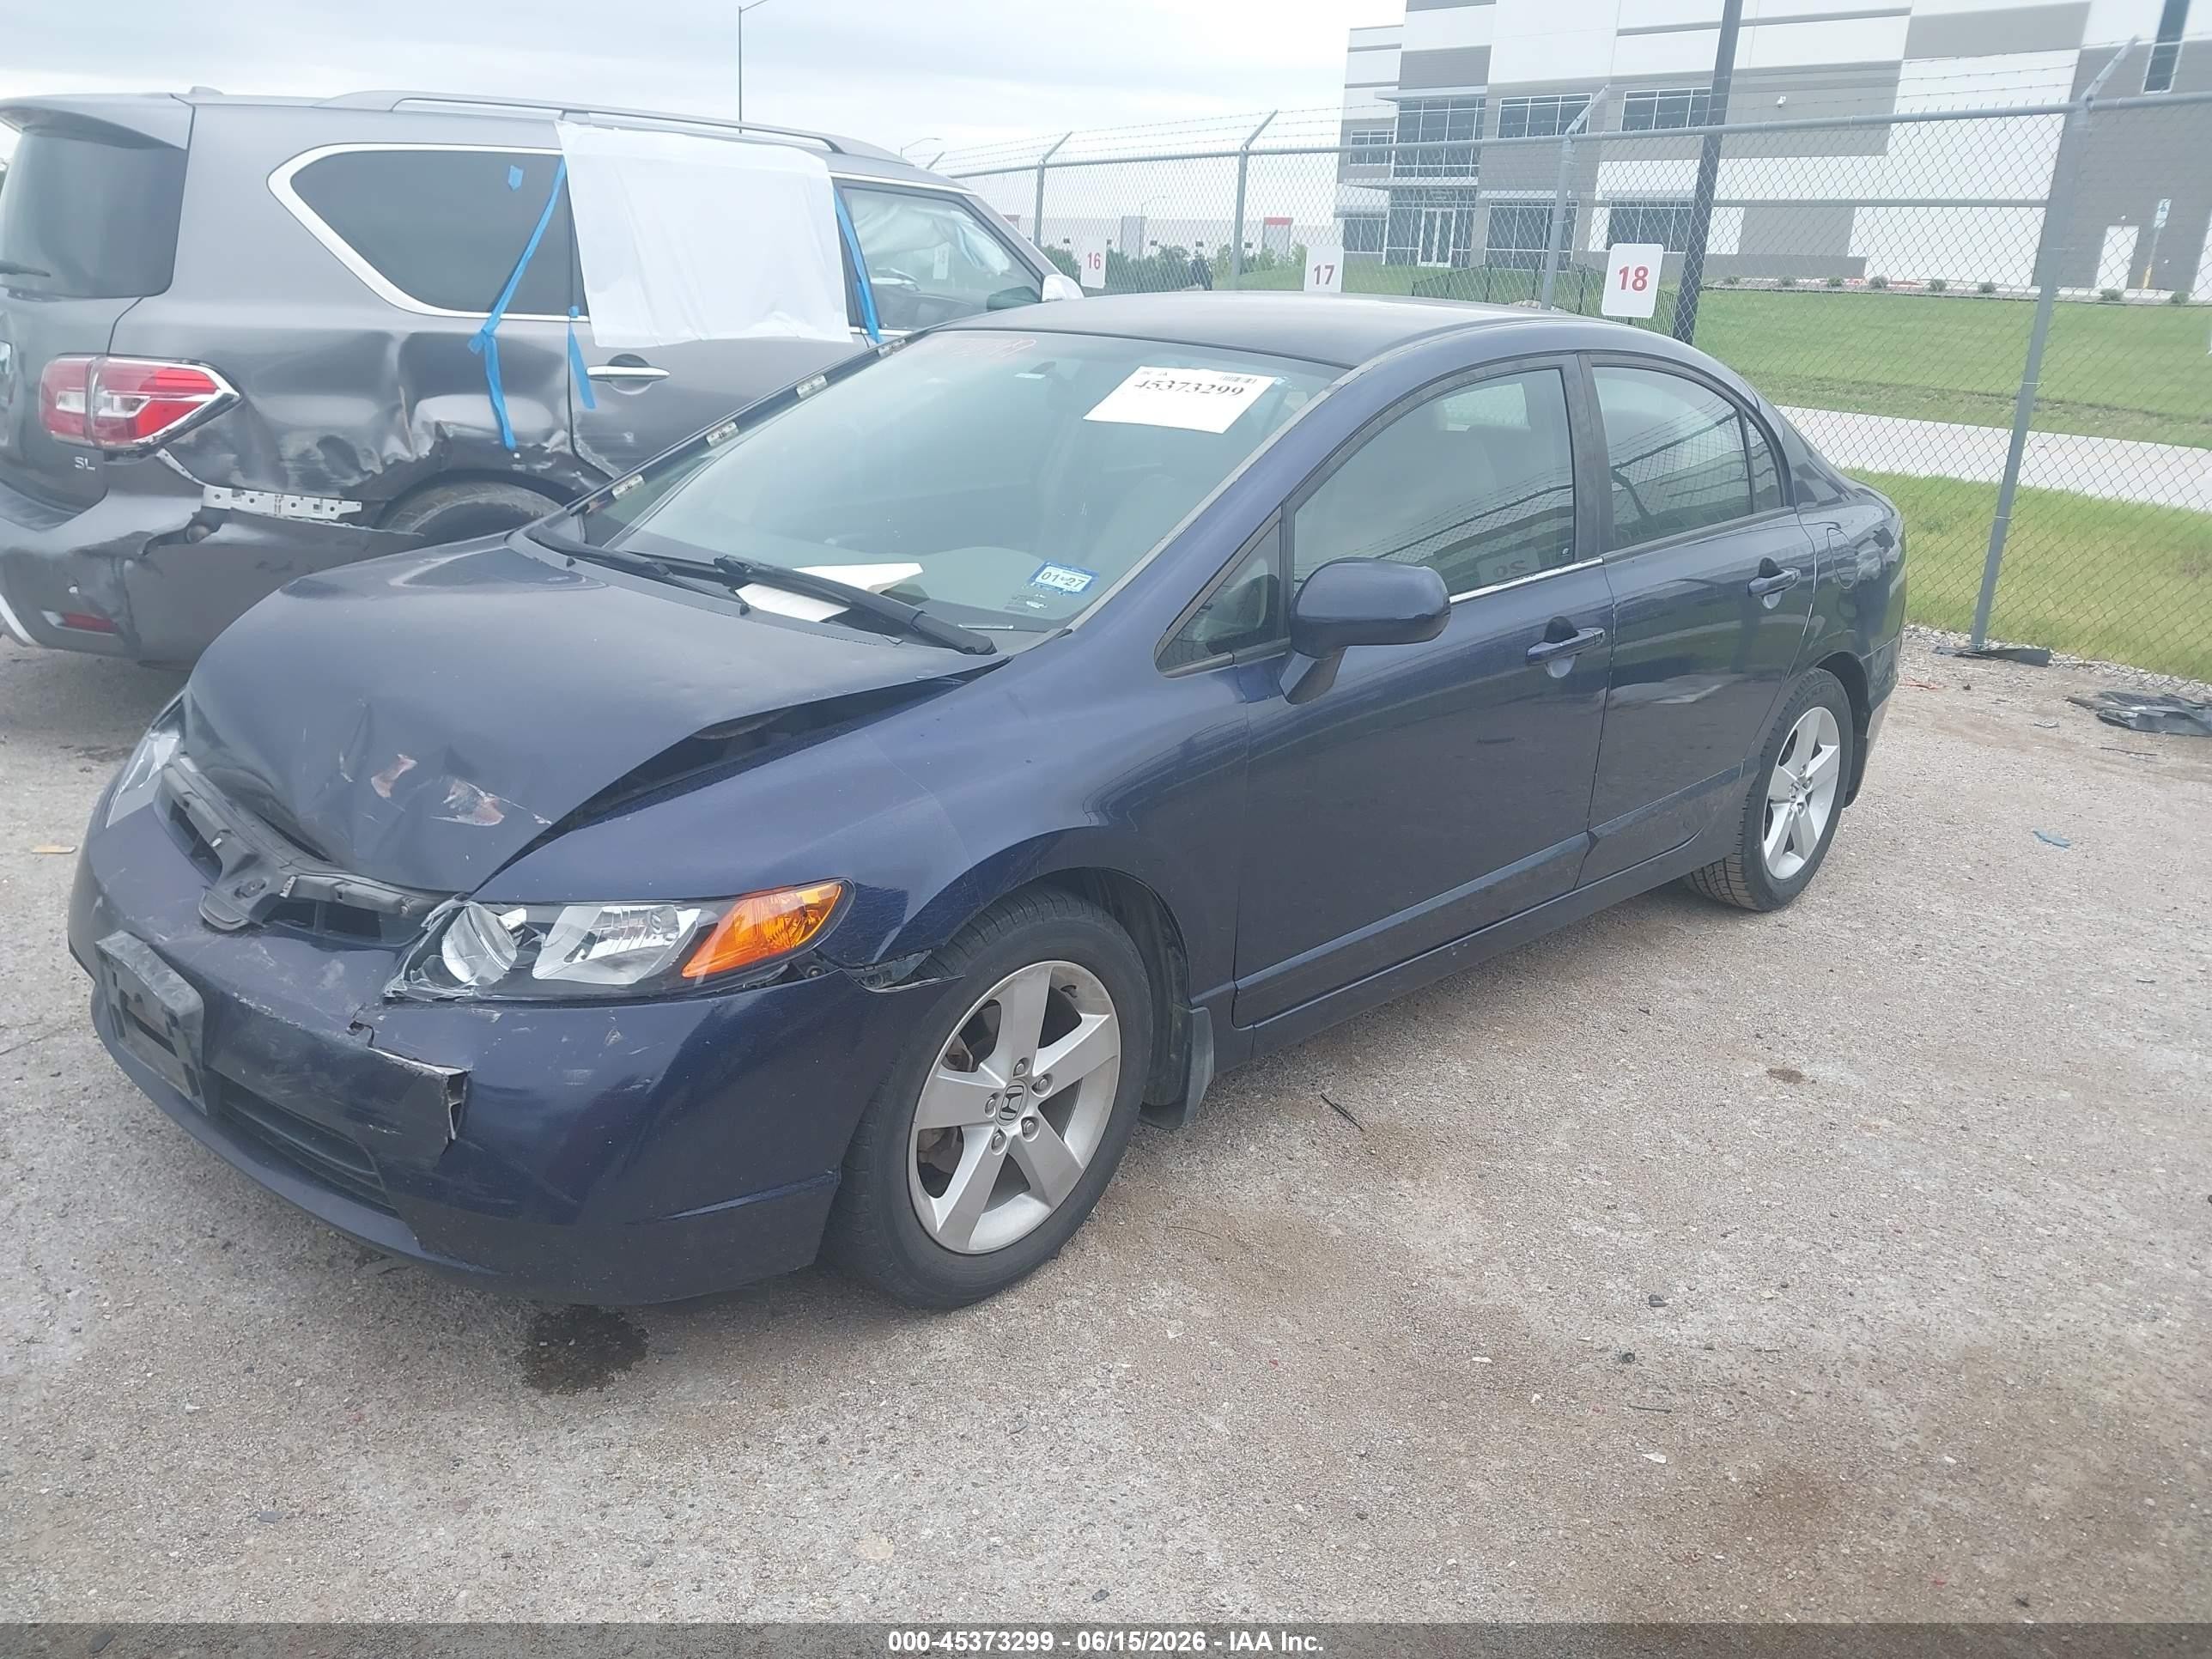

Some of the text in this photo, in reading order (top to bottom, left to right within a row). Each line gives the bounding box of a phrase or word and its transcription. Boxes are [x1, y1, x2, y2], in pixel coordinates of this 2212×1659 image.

[1087, 252, 1101, 270] 16
[1314, 264, 1335, 284] 17
[1619, 265, 1649, 291] 18
[1134, 380, 1244, 396] 45373299
[75, 456, 96, 471] SL
